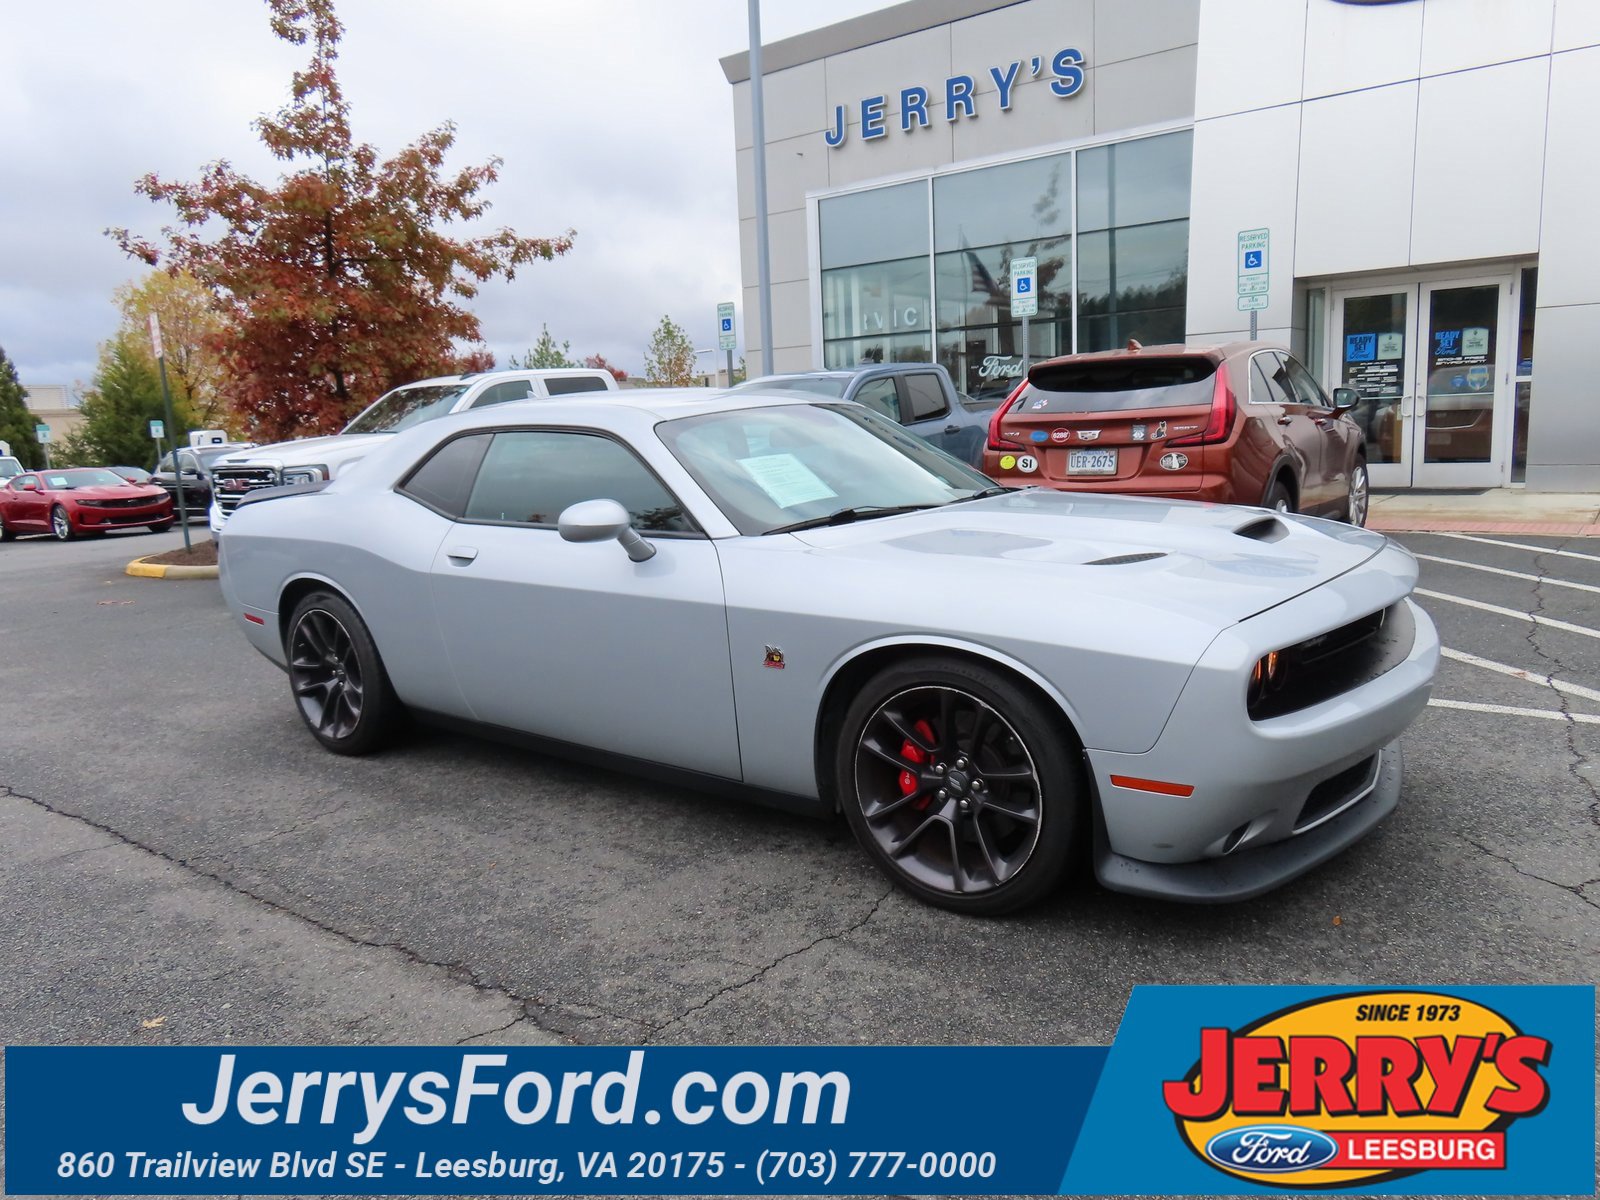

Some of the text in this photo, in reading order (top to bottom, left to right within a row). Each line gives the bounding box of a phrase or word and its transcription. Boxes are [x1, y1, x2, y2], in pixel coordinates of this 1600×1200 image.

[824, 48, 1086, 147] JERRY'S
[1240, 232, 1268, 242] RESERVED
[1241, 241, 1266, 250] PARKING
[978, 355, 1025, 377] Ford
[1021, 458, 1033, 469] SI
[1070, 455, 1115, 468] UER-2675
